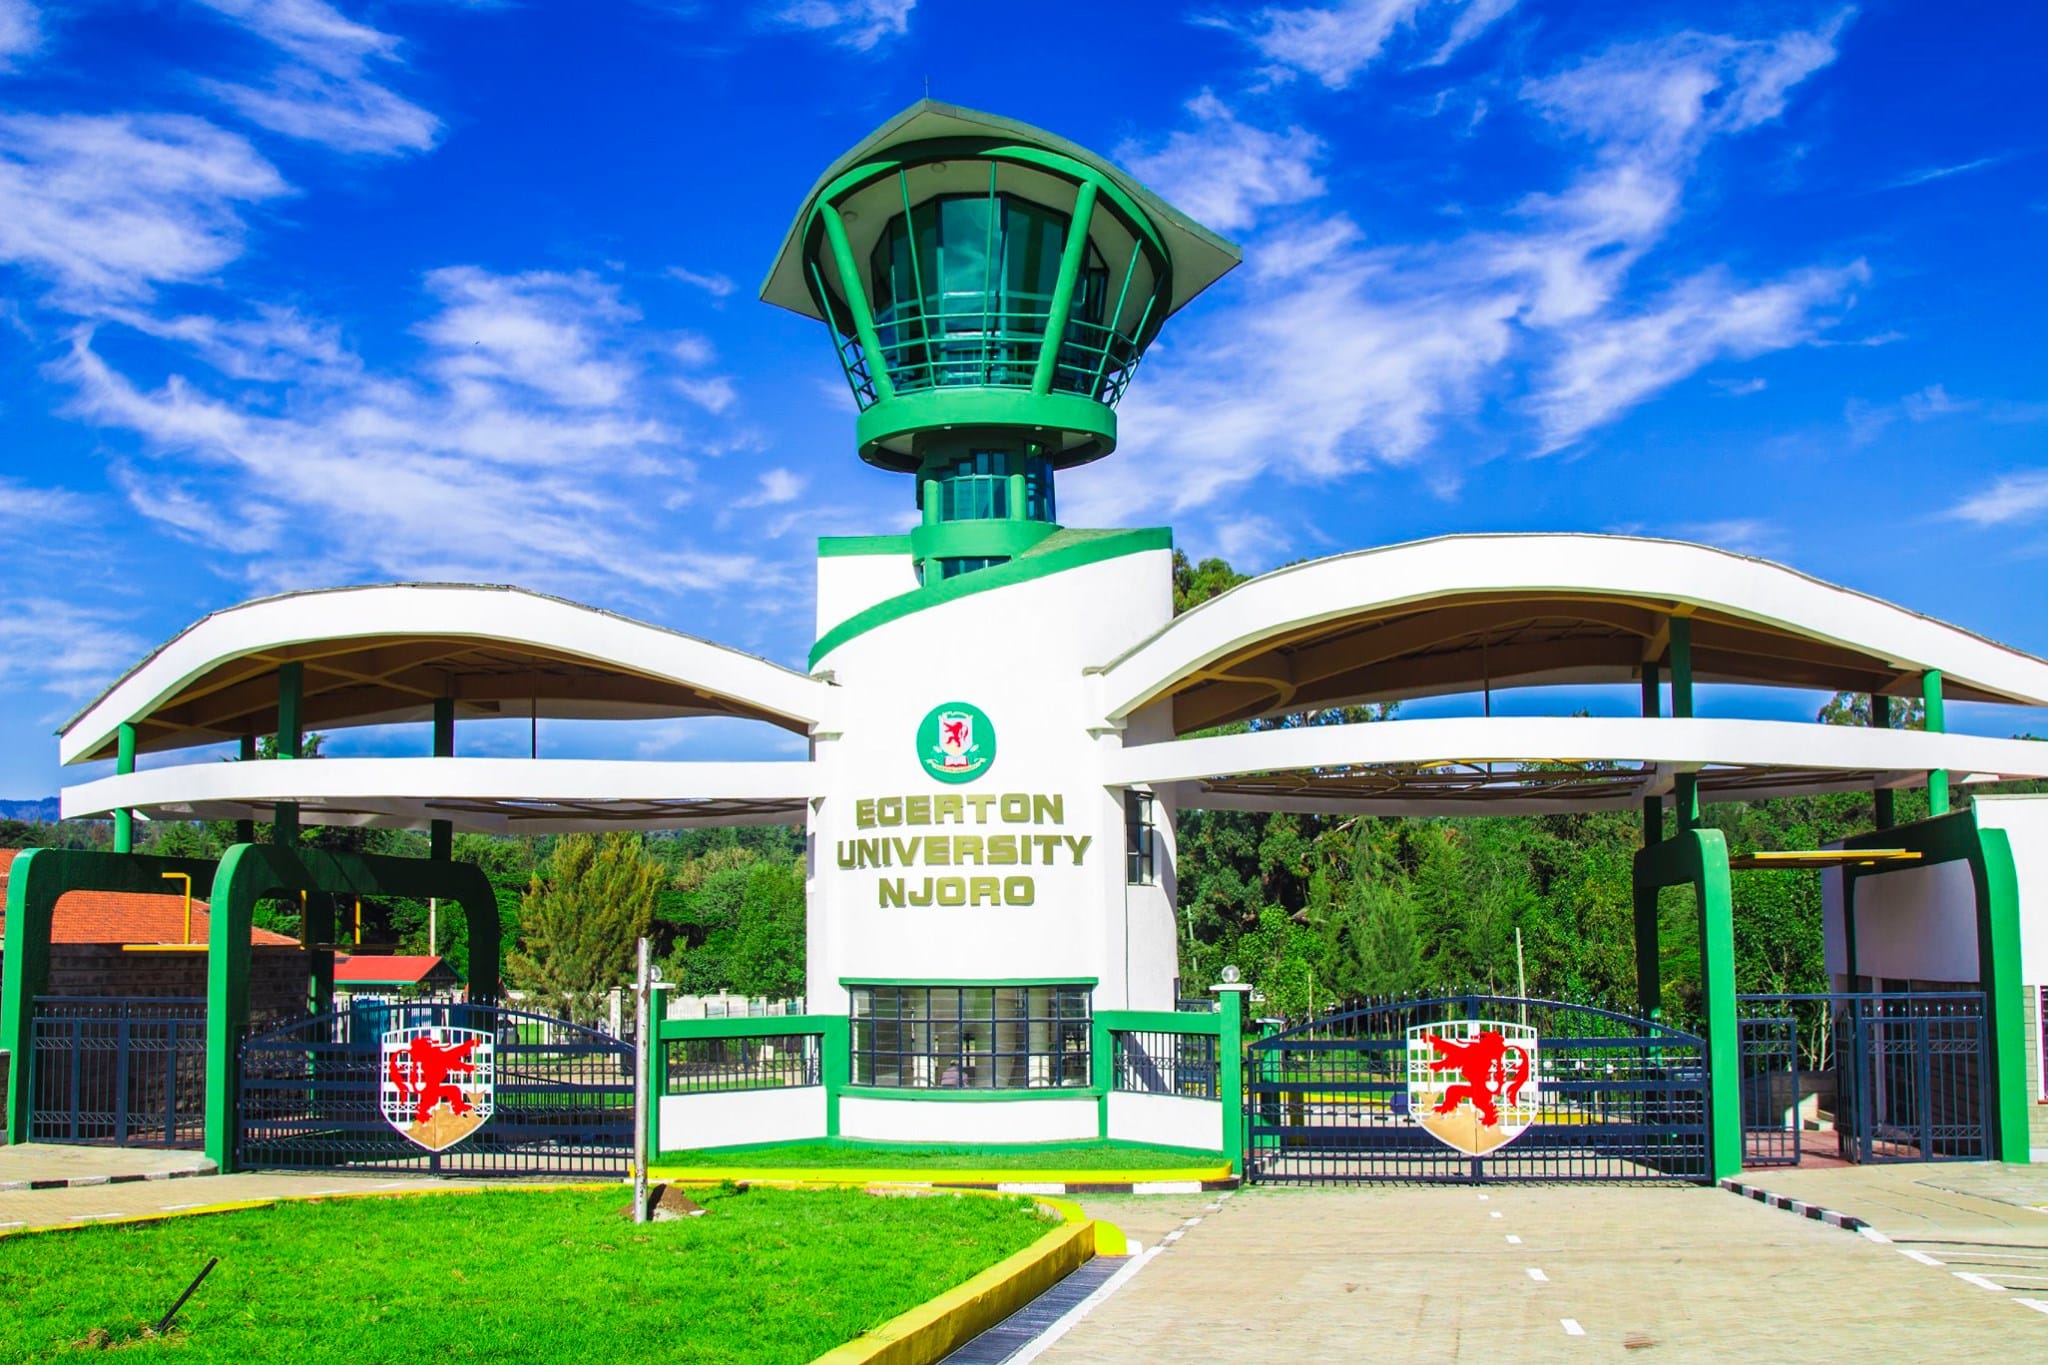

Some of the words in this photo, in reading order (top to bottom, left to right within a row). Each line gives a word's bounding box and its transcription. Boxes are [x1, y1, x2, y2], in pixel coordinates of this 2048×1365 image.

[856, 793, 1064, 828] EGERTON
[837, 835, 1092, 868] UNIVERSITY
[879, 876, 1035, 907] NJORO
